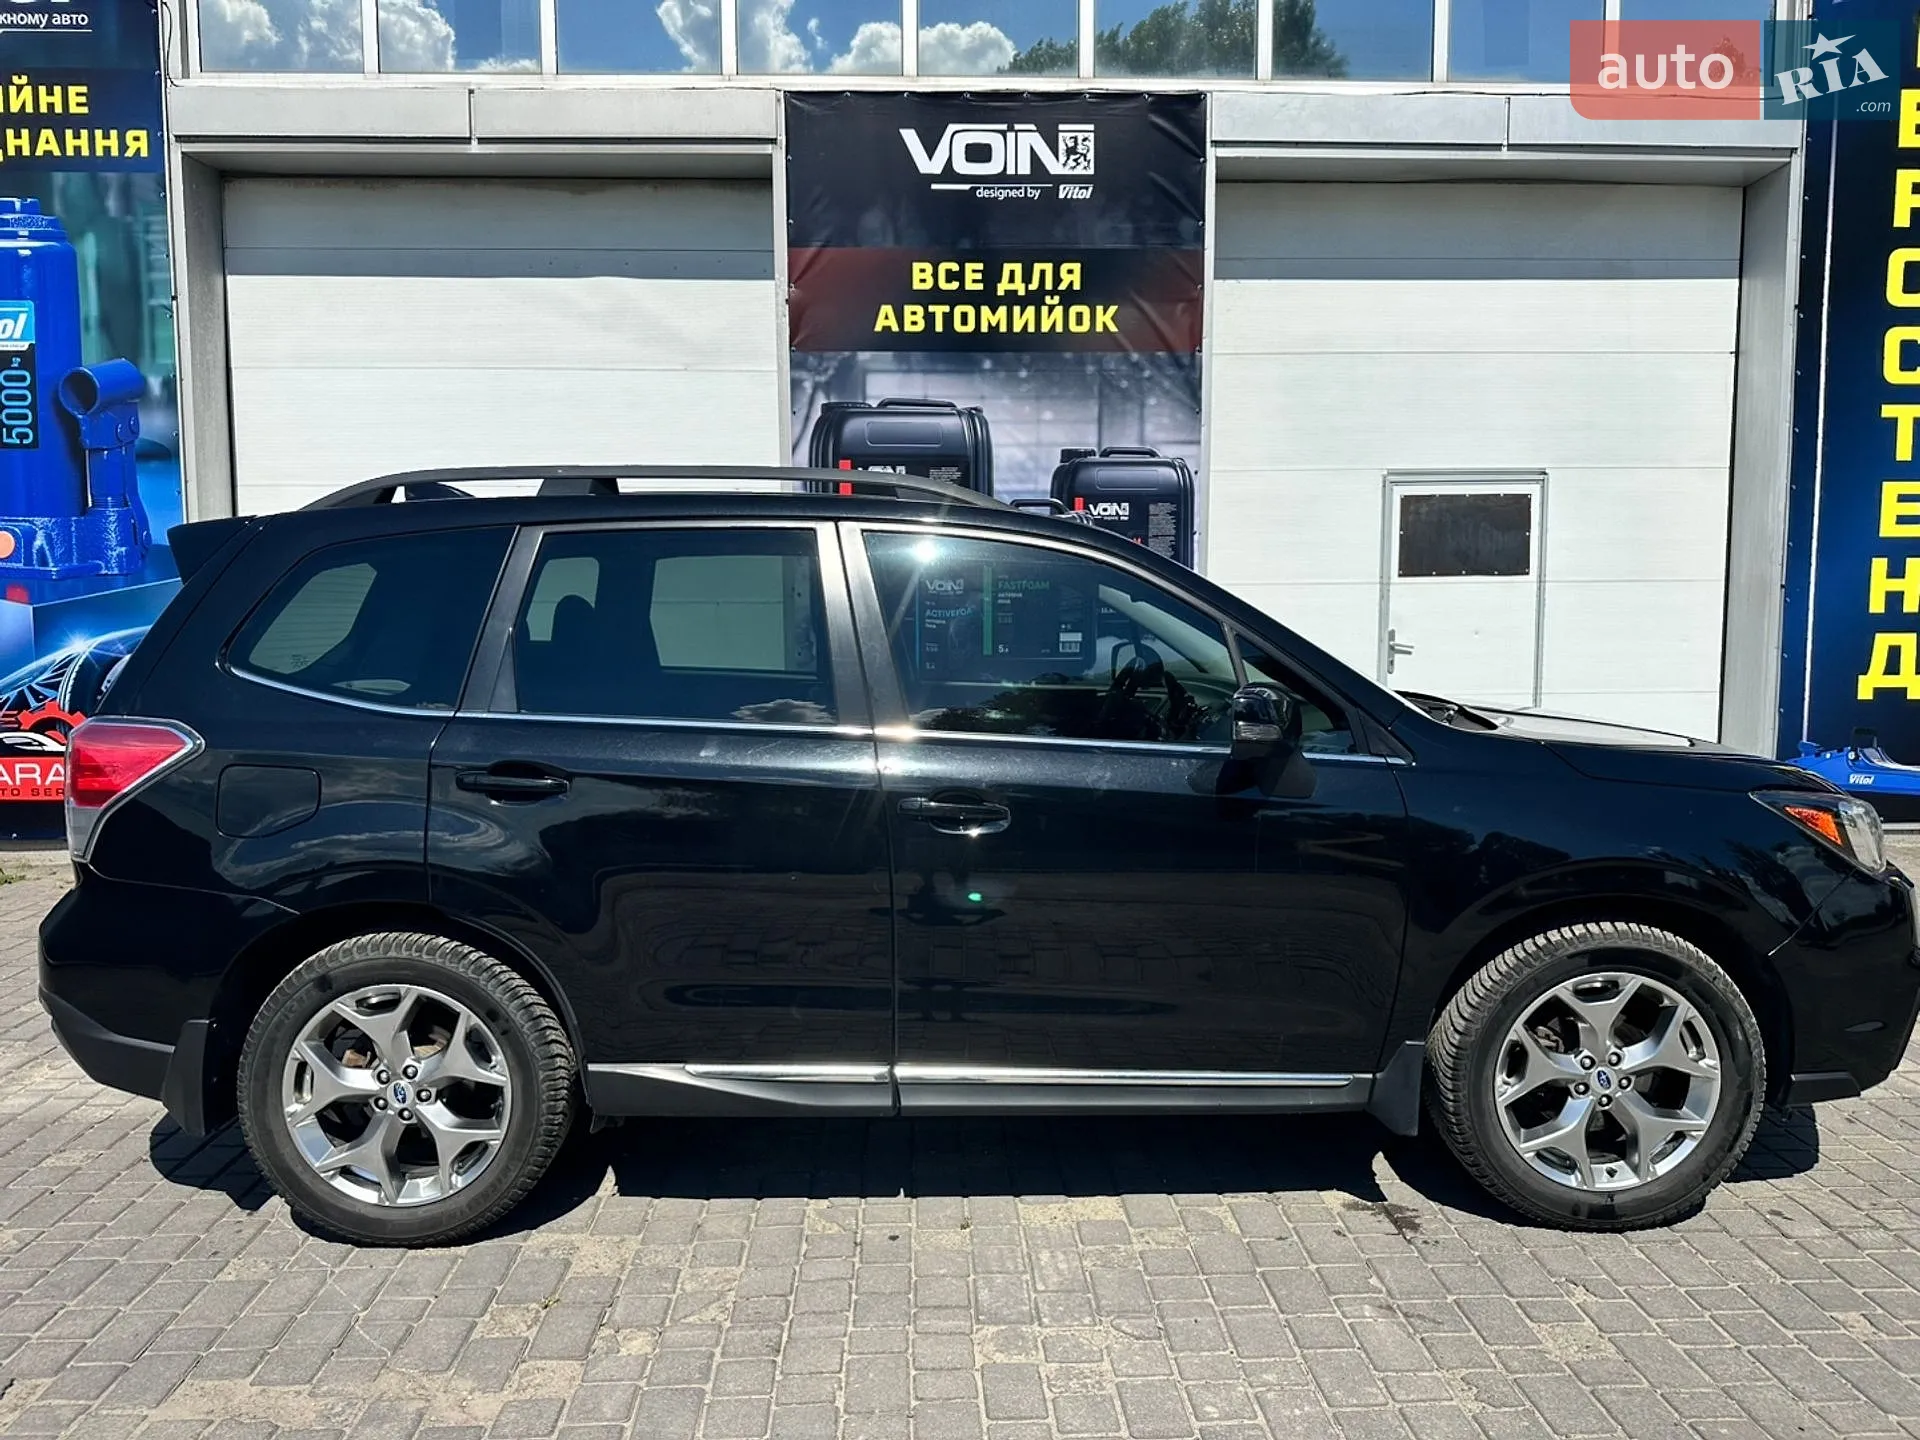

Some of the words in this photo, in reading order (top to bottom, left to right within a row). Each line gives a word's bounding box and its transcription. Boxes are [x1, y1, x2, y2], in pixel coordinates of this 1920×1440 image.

[52, 13, 89, 26] авто
[0, 74, 89, 114] ЙНЕ
[0, 128, 149, 162] НАННЯ
[975, 186, 1024, 200] designed
[1026, 186, 1042, 200] by
[1058, 184, 1094, 200] Vitol
[911, 262, 984, 291] ВСЕ
[997, 262, 1082, 296] ДЛЯ
[874, 295, 1119, 332] АВТОМИЙОК
[0, 369, 34, 444] 5000
